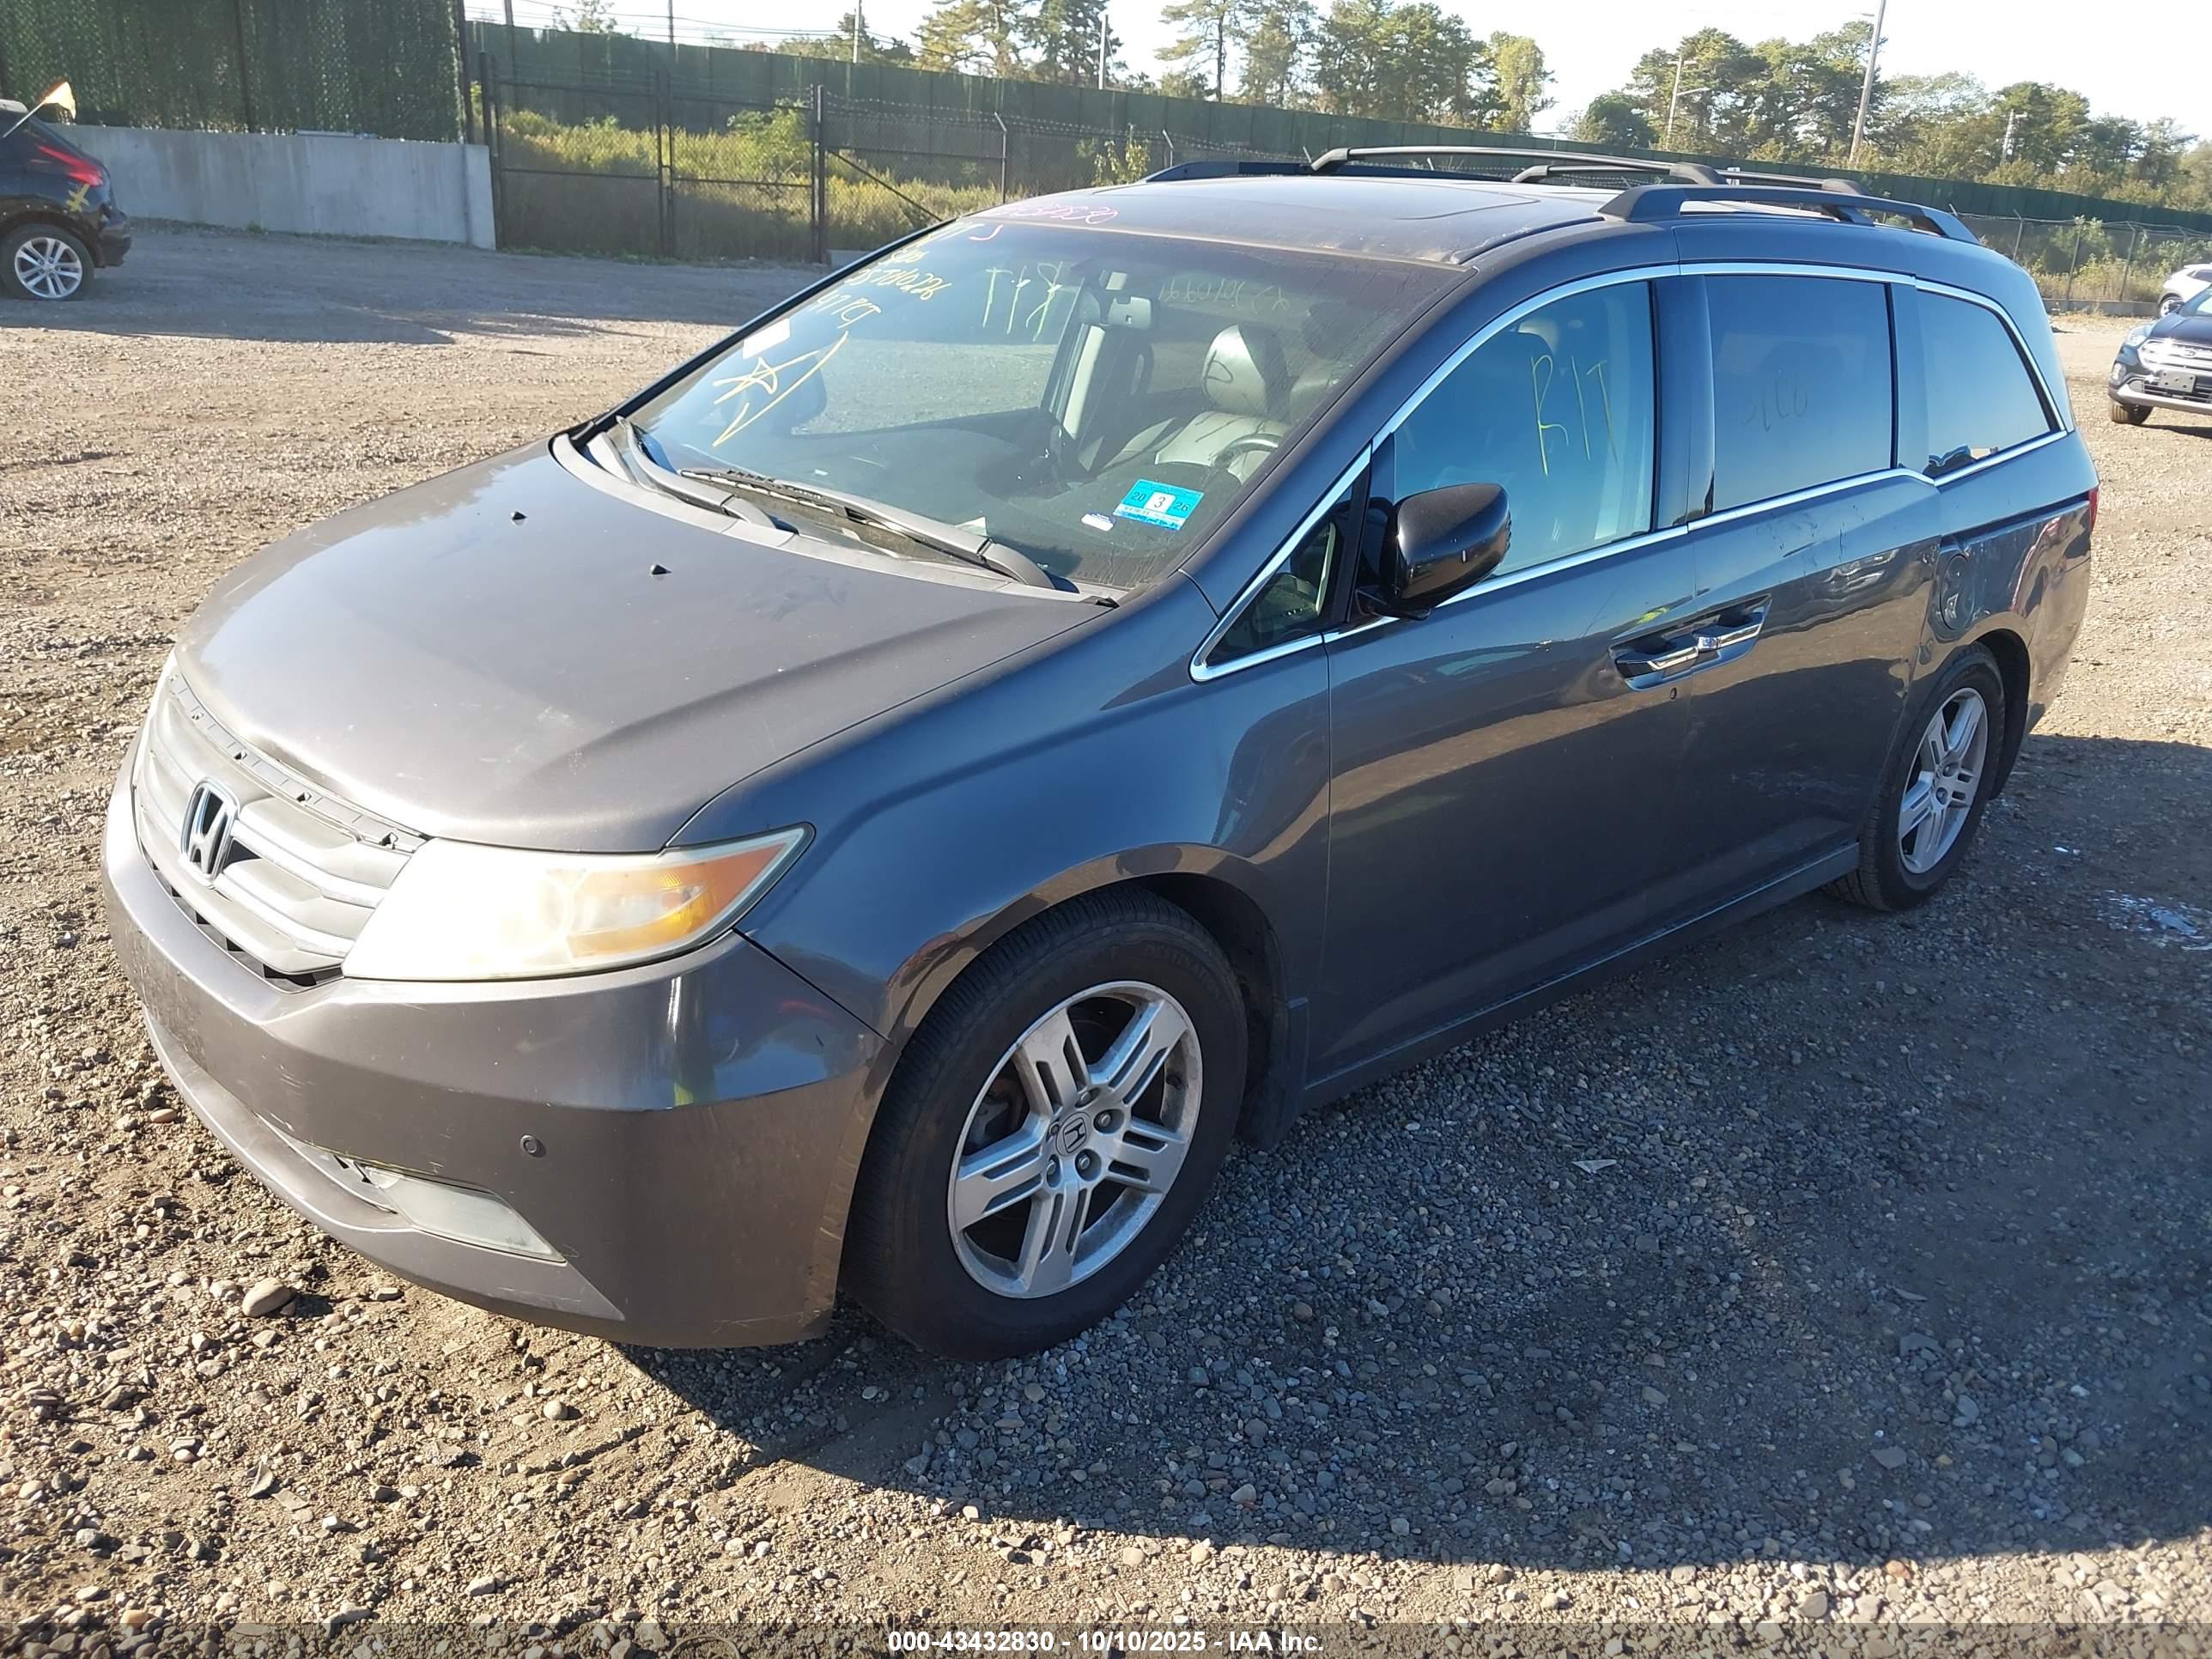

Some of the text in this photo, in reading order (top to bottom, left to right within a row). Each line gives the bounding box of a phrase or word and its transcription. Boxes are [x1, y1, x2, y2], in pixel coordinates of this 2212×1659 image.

[1531, 355, 1620, 475] RIT
[1131, 491, 1191, 512] 20 3 26
